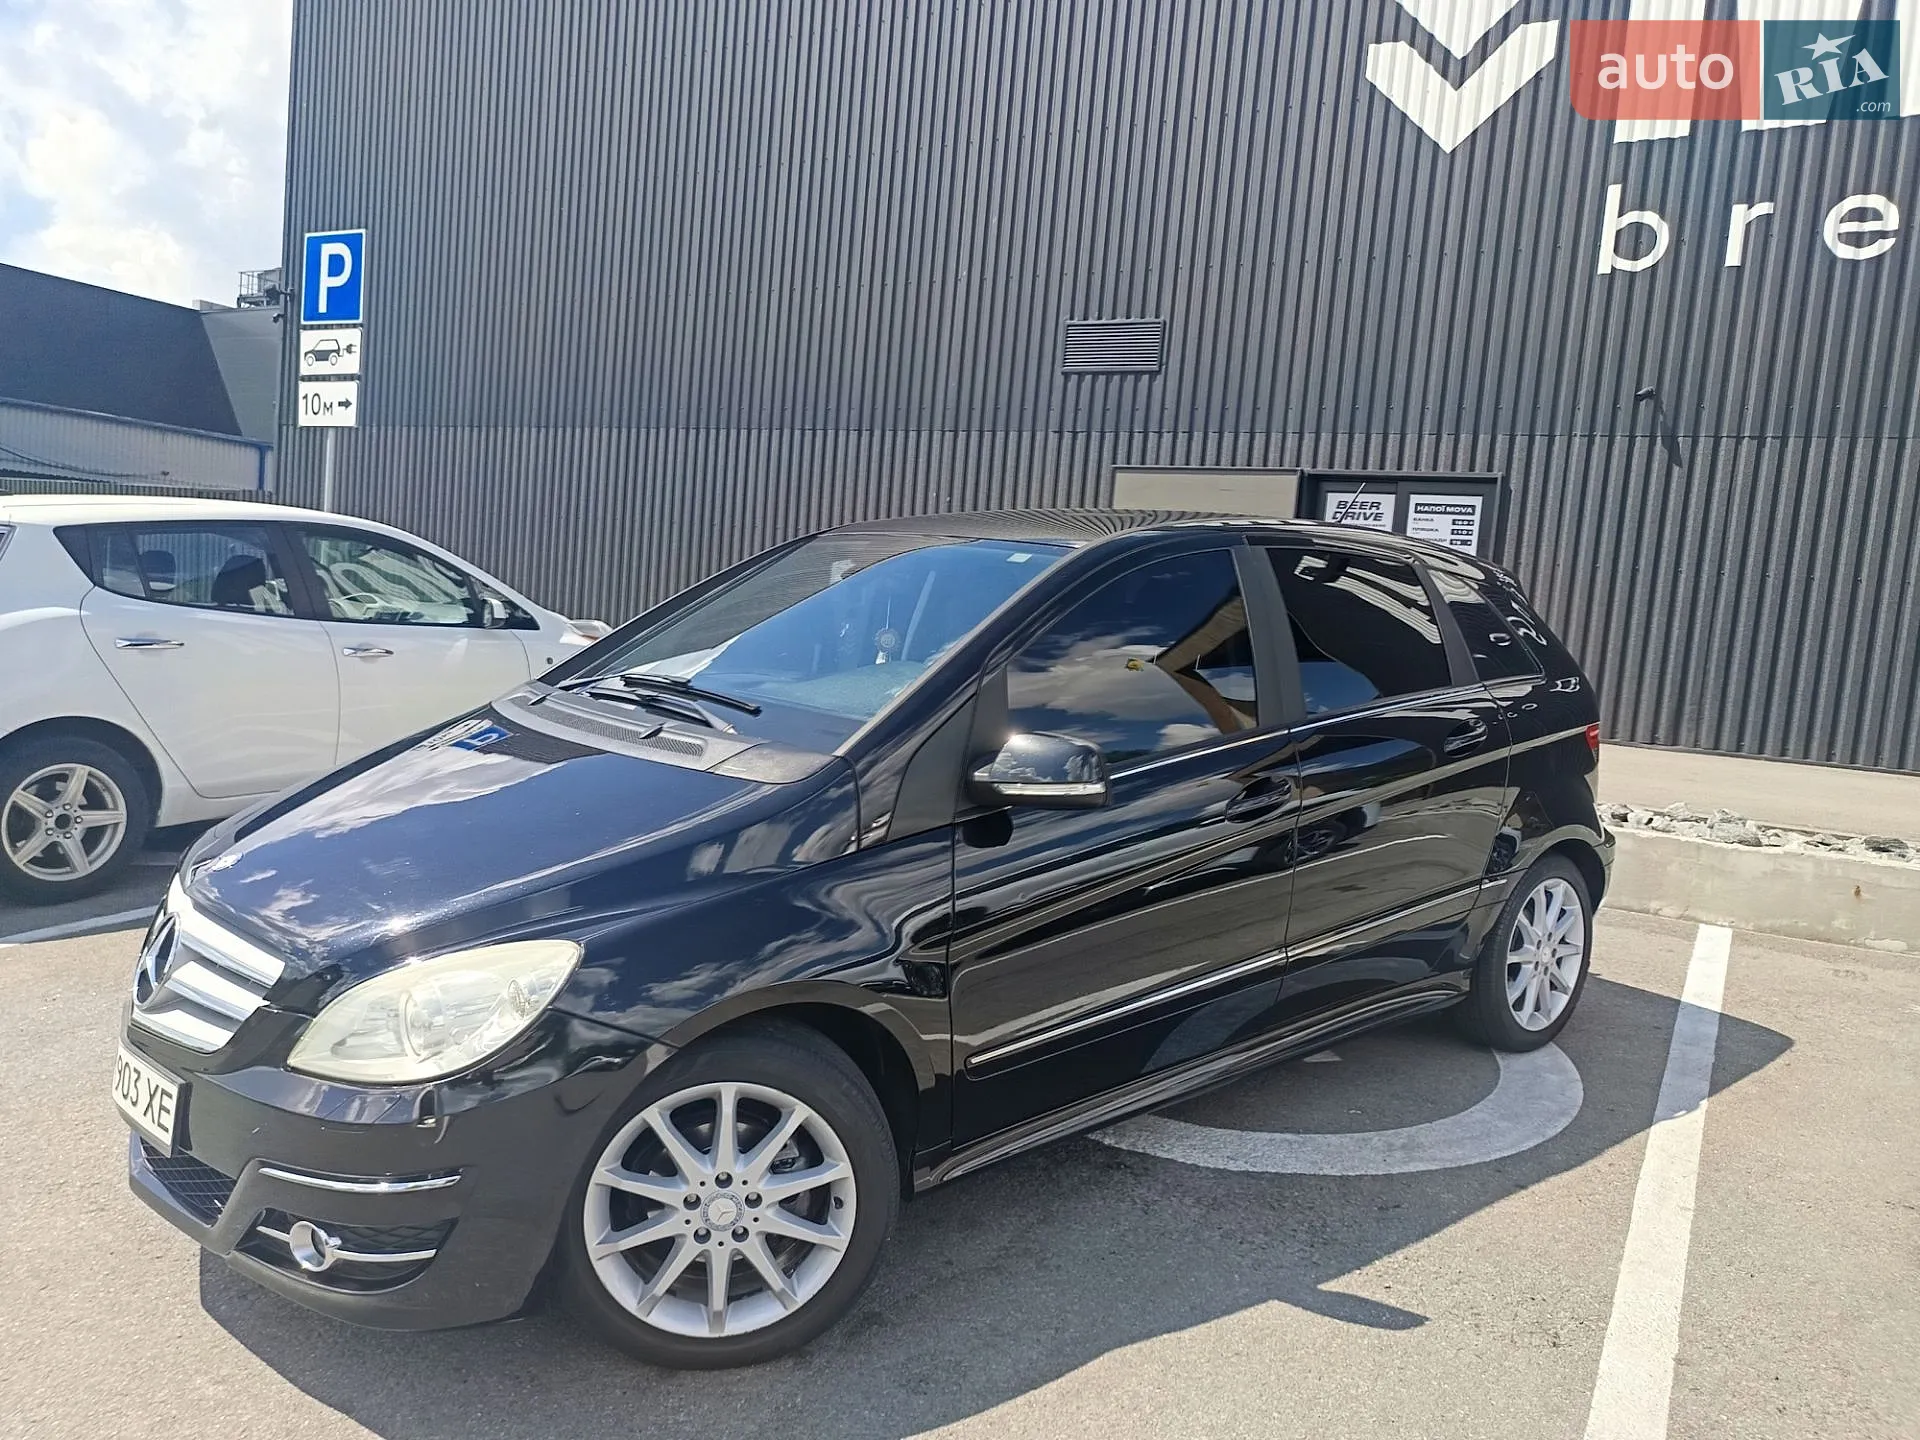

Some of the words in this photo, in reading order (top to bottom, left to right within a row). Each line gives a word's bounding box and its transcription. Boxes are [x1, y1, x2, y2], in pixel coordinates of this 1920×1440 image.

[318, 242, 353, 314] P
[1336, 500, 1382, 511] BEER
[1332, 511, 1385, 521] DRIVE
